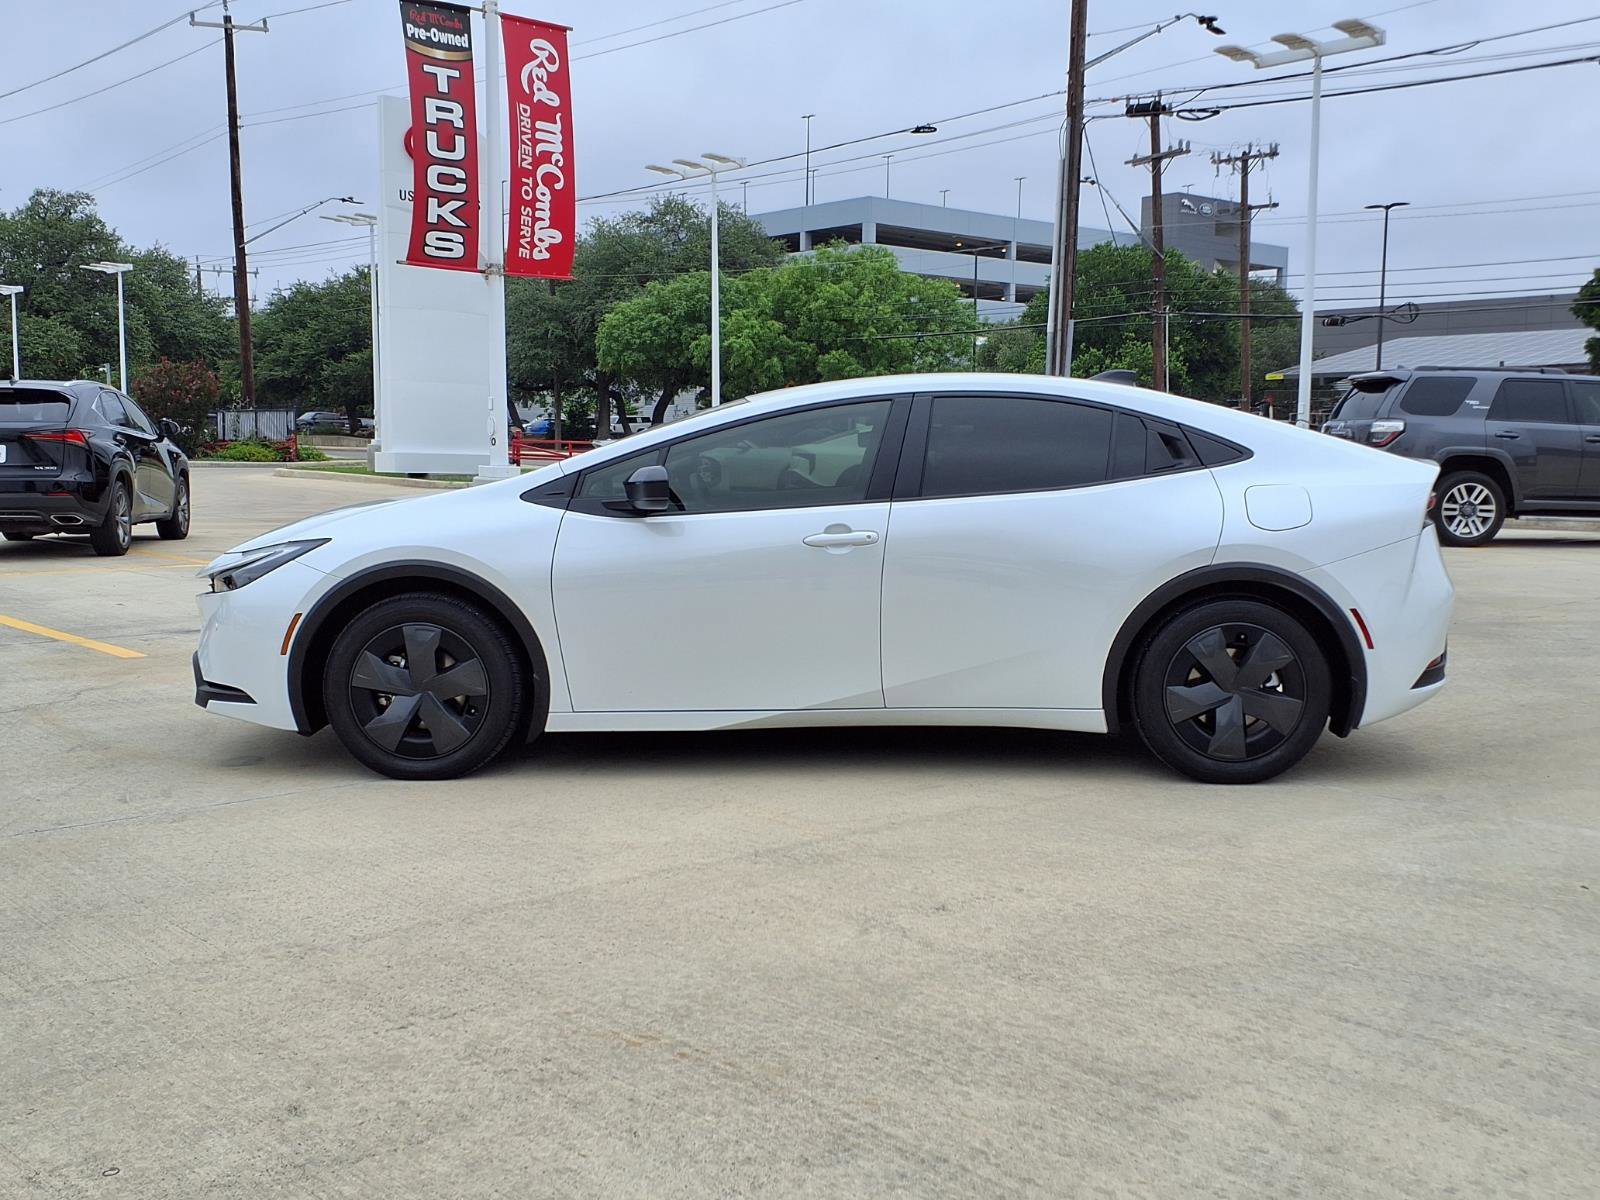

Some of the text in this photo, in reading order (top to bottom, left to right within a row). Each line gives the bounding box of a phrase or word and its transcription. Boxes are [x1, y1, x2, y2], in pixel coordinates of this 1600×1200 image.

[406, 23, 469, 48] Pre-Owned
[422, 63, 470, 260] TRUCKS
[518, 103, 533, 260] DRIVEN TO SERVE
[520, 38, 565, 260] Red McCombs
